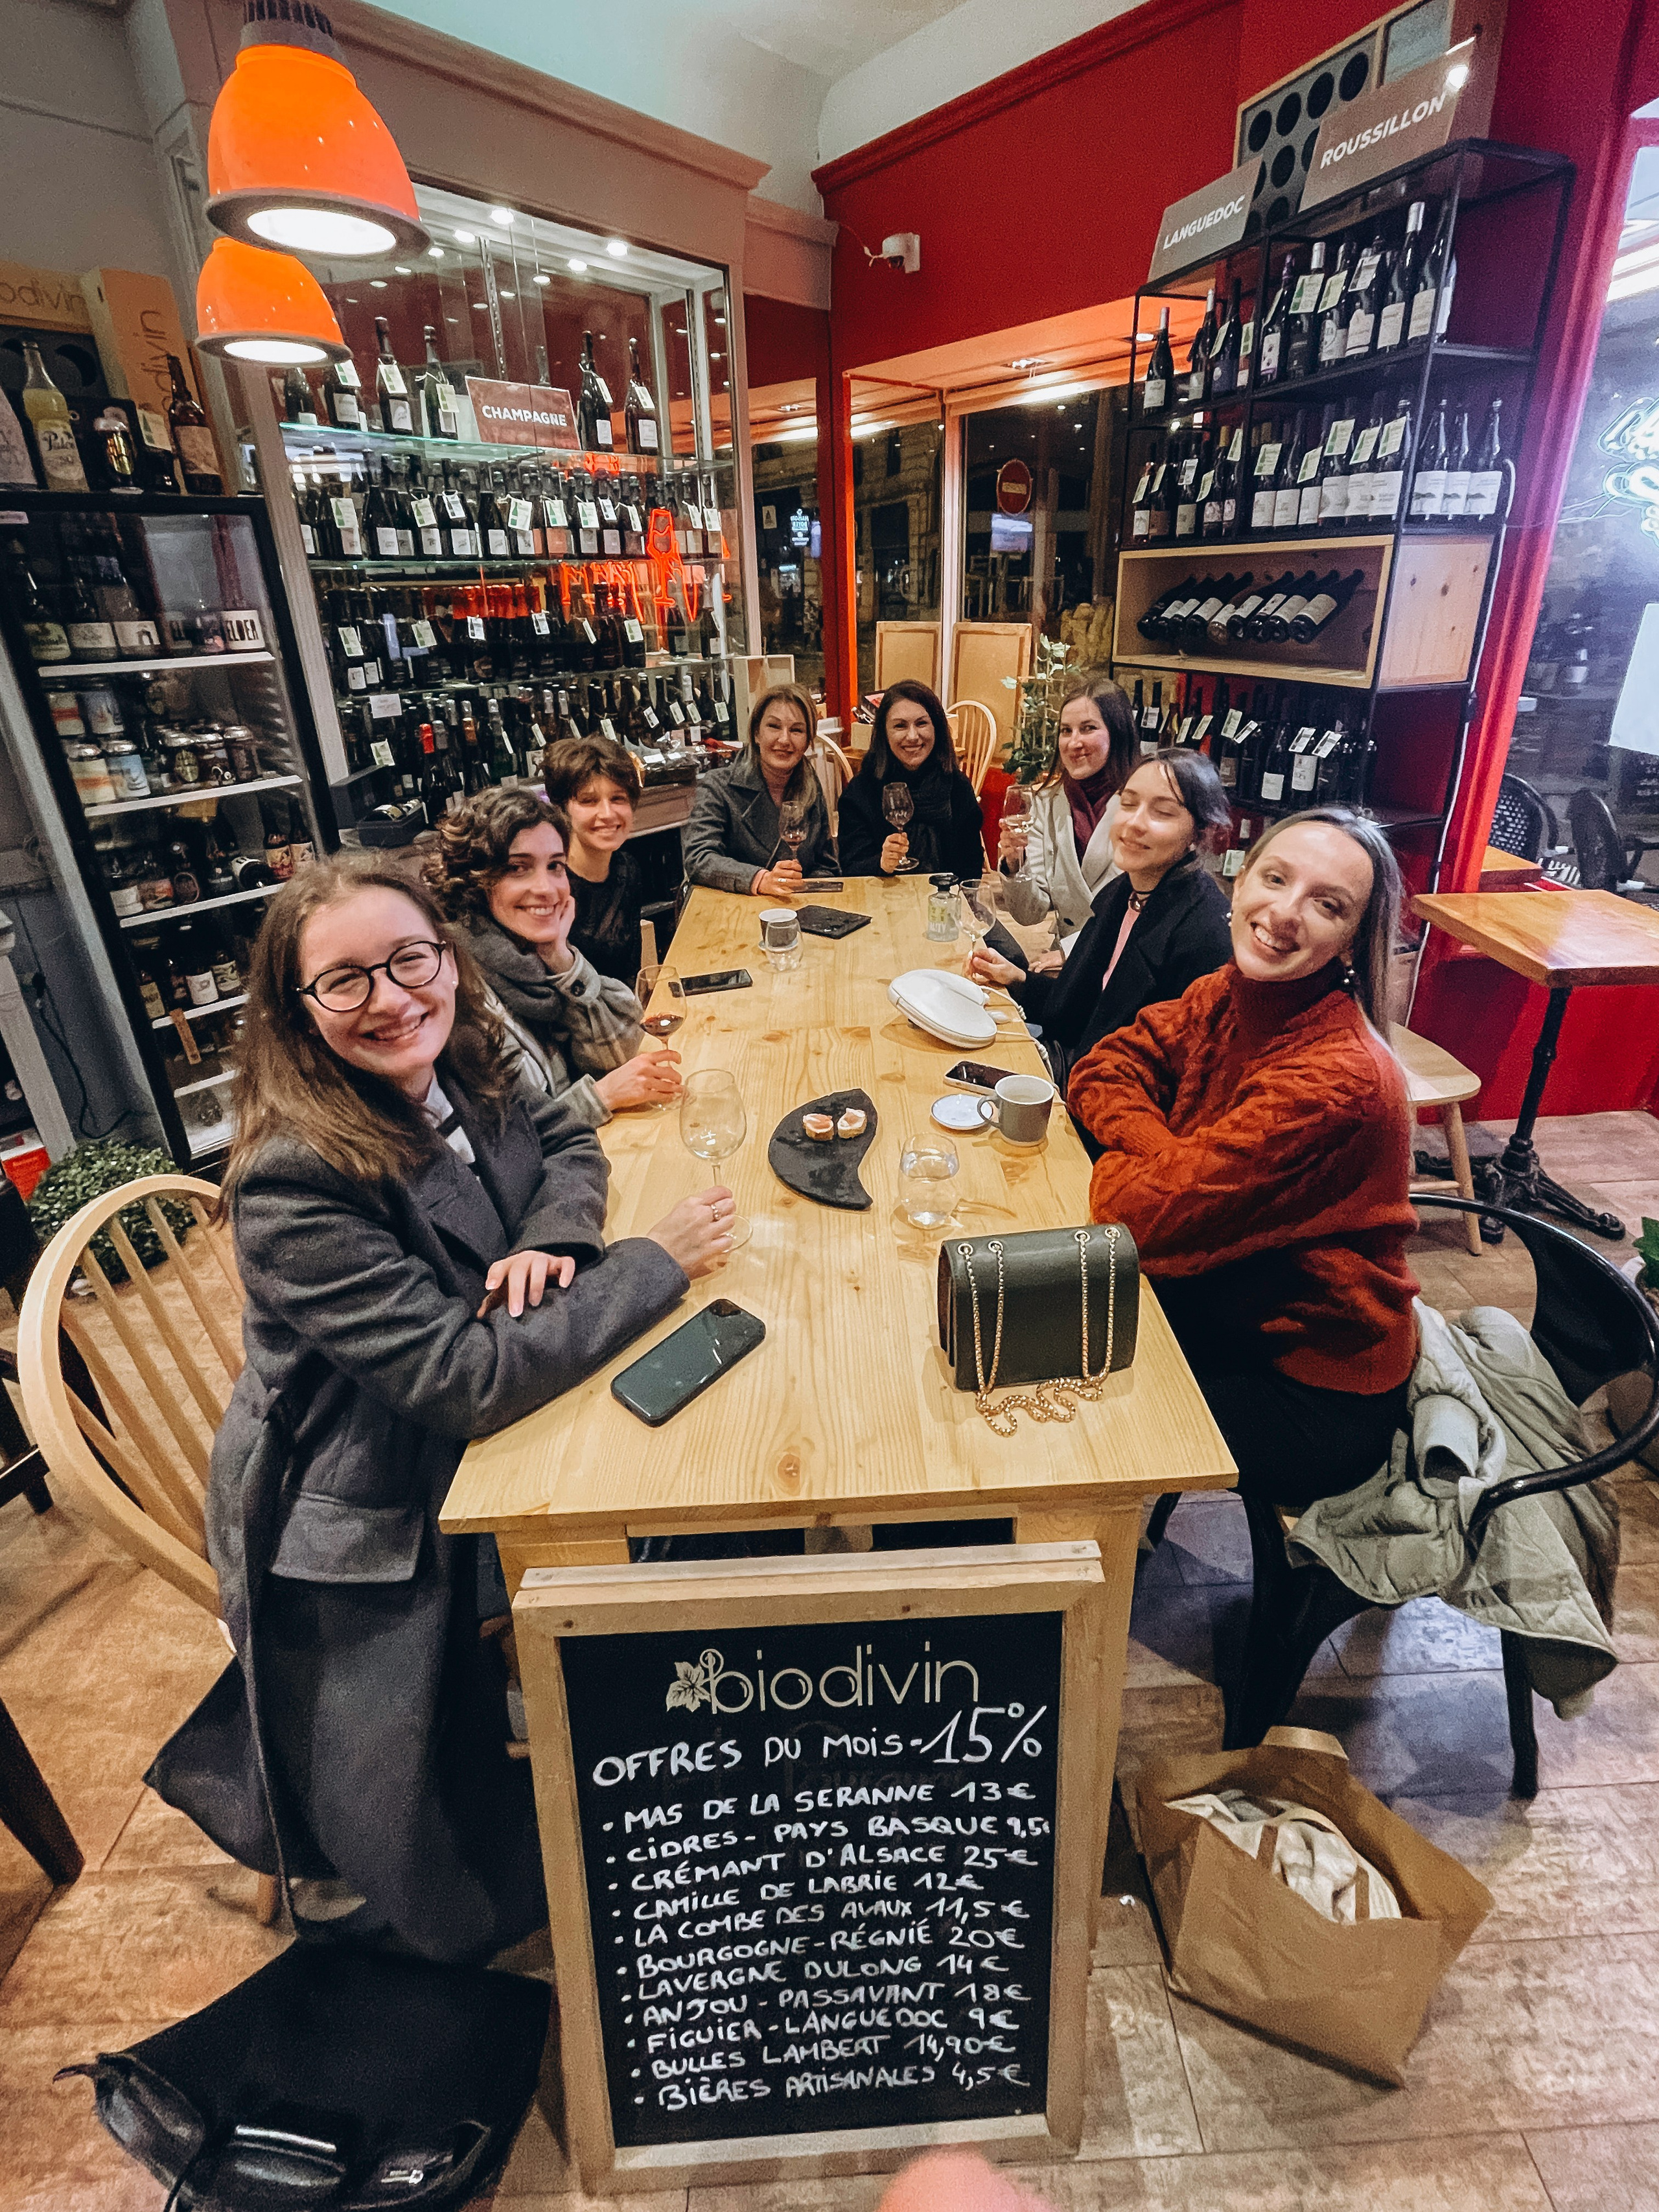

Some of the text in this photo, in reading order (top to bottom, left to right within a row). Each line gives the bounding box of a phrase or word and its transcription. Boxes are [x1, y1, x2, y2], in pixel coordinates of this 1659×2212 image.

[1319, 91, 1446, 170] ROUSSILLON
[1163, 194, 1246, 250] LANGUEDOC
[481, 404, 568, 427] CHAMPAGNE
[699, 1642, 980, 1714] biodivin
[592, 1739, 743, 1787] OFFRES
[764, 1736, 802, 1768] DU
[623, 1781, 1037, 1834] MAS DE LA SERANNE 13€
[773, 1820, 850, 1843] PAYS
[867, 1815, 998, 1837] BASQUE
[631, 1842, 1039, 1891] CRÉMANT D'ALSACE 25€
[759, 1881, 796, 1901] DE
[912, 1871, 985, 1892] 12€
[634, 1923, 669, 1948] LA
[677, 1909, 767, 1940] COMBE
[775, 1903, 826, 1925] DES
[840, 1898, 913, 1919] AVAUX
[947, 1926, 1026, 1950] 20€
[638, 1960, 787, 2001] LAVERGNE
[804, 1955, 922, 1980] DULONG
[642, 1994, 748, 2027] ANJOU
[778, 1981, 946, 2010] PASSAVANT
[953, 1982, 1032, 2004] 18€
[651, 2032, 1017, 2080] BULLES LAMBERT 14,90€
[951, 2061, 1031, 2091] 4,5€
